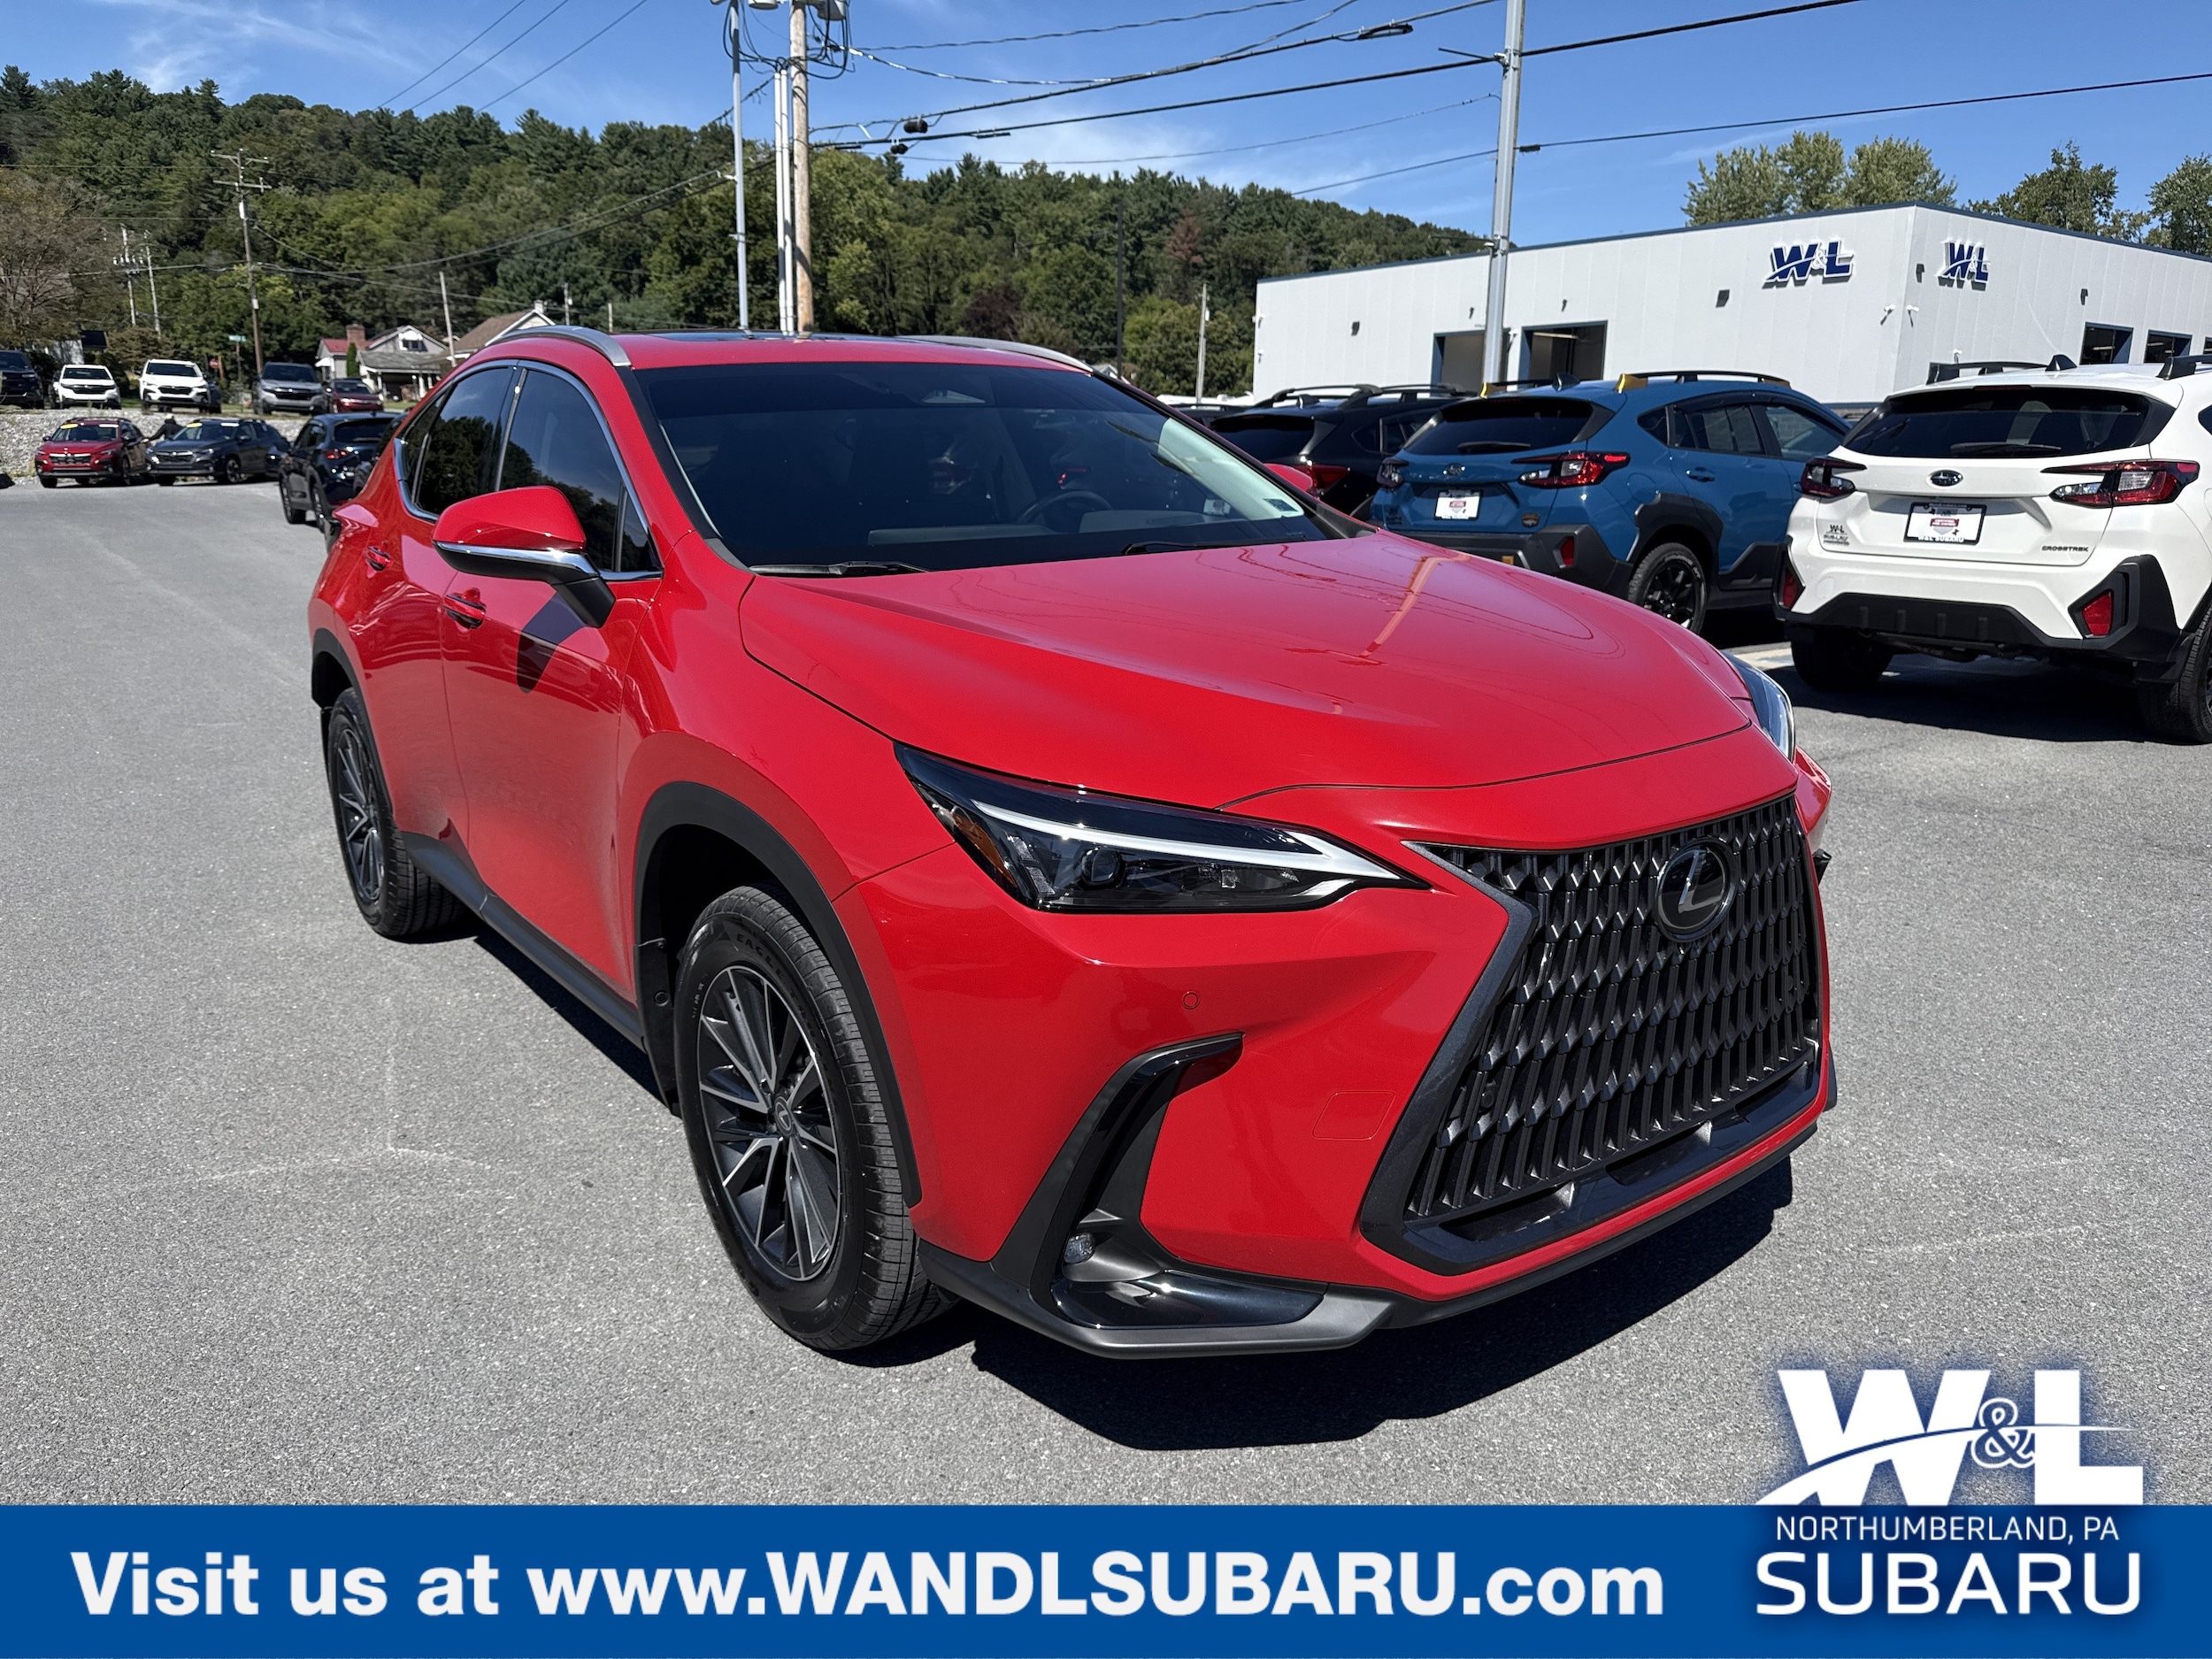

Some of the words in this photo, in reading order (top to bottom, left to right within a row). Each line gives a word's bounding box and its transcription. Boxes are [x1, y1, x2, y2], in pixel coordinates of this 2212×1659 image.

[1765, 241, 1853, 282] W&L
[1941, 242, 1989, 283] W&L
[736, 933, 785, 980] EAGLE
